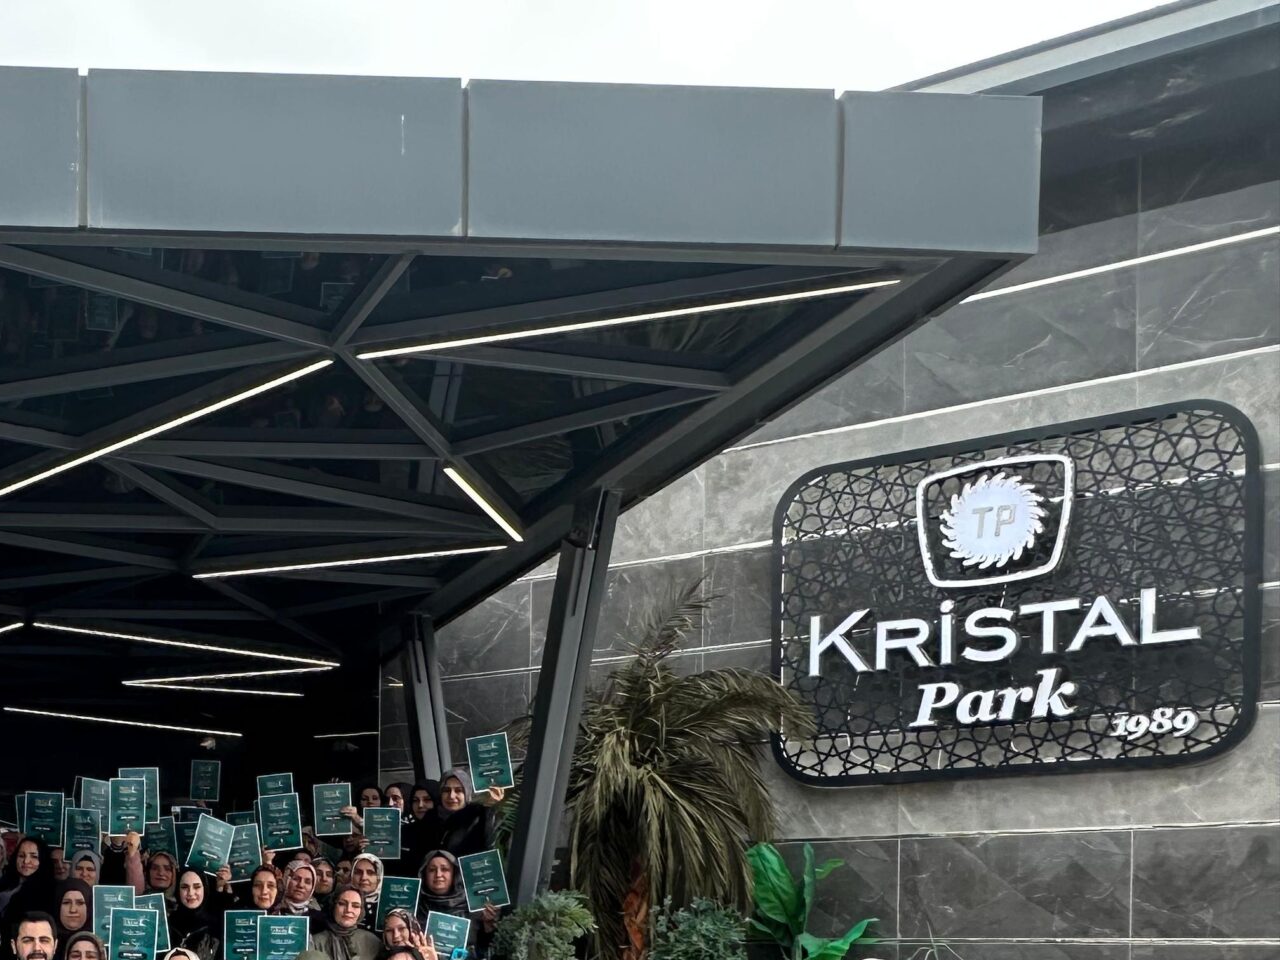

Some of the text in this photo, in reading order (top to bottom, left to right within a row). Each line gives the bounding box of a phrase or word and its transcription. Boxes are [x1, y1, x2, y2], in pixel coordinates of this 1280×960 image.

[972, 503, 1017, 538] TP
[908, 667, 1078, 728] Park
[1109, 707, 1200, 740] 1989
